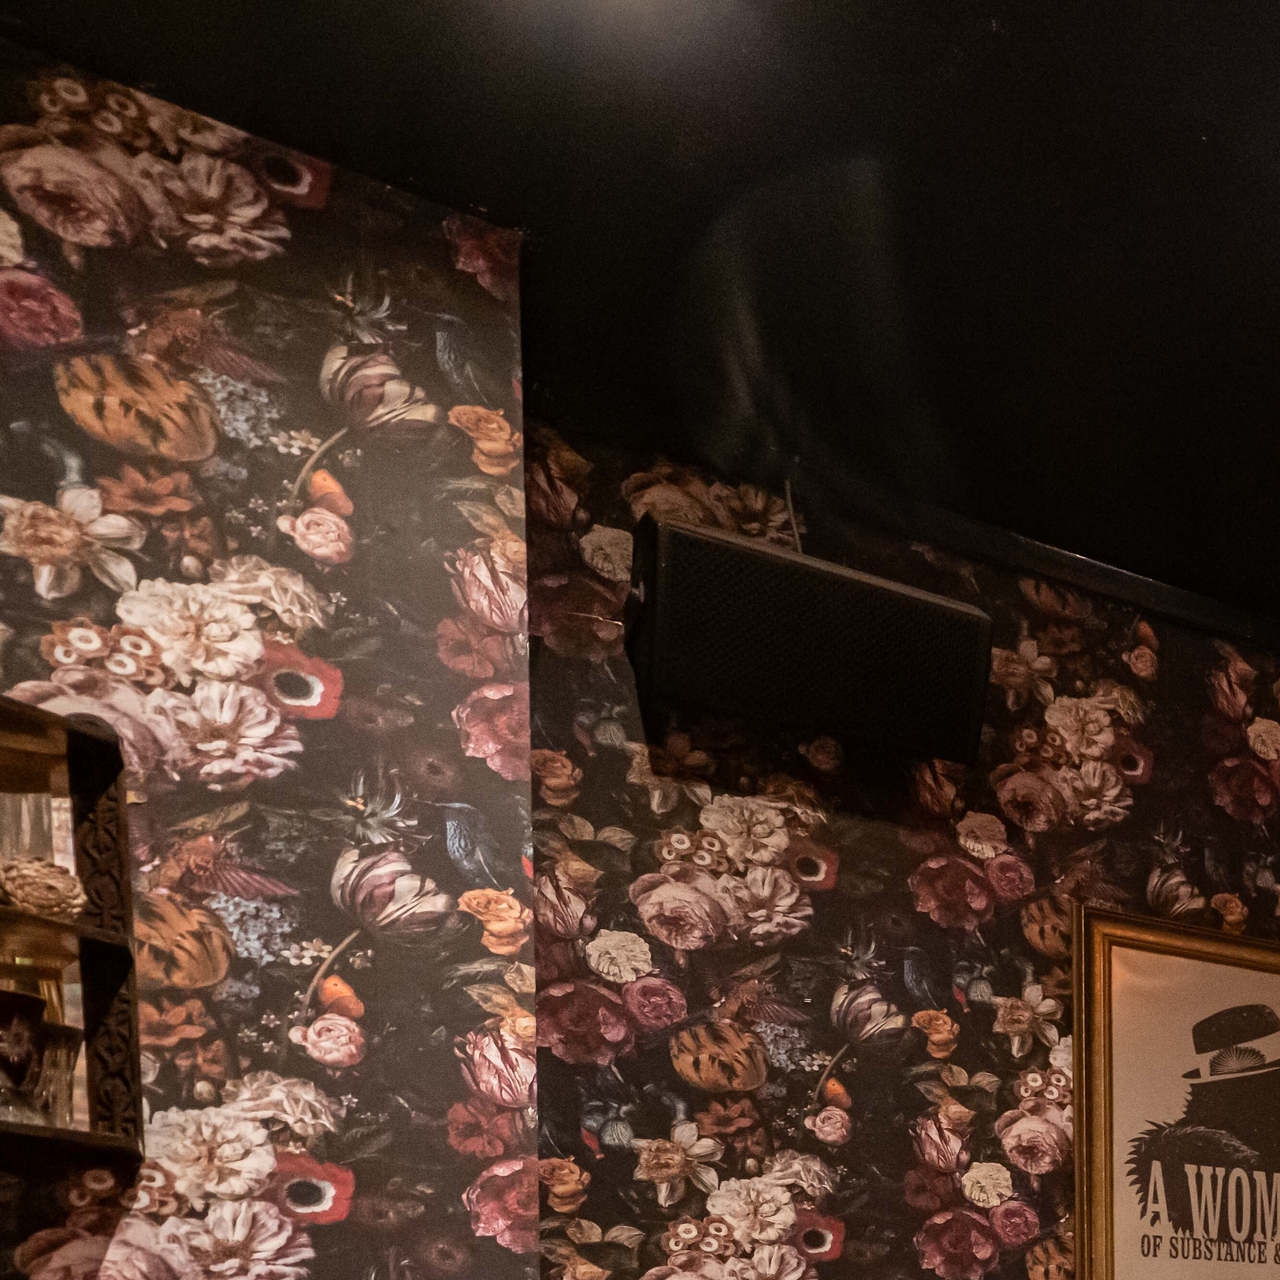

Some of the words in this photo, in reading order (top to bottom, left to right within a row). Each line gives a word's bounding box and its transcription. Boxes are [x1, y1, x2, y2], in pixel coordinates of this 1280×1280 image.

[1145, 1160, 1171, 1226] A
[1141, 1234, 1162, 1258] OF
[1169, 1235, 1267, 1264] SUBSTANCE
